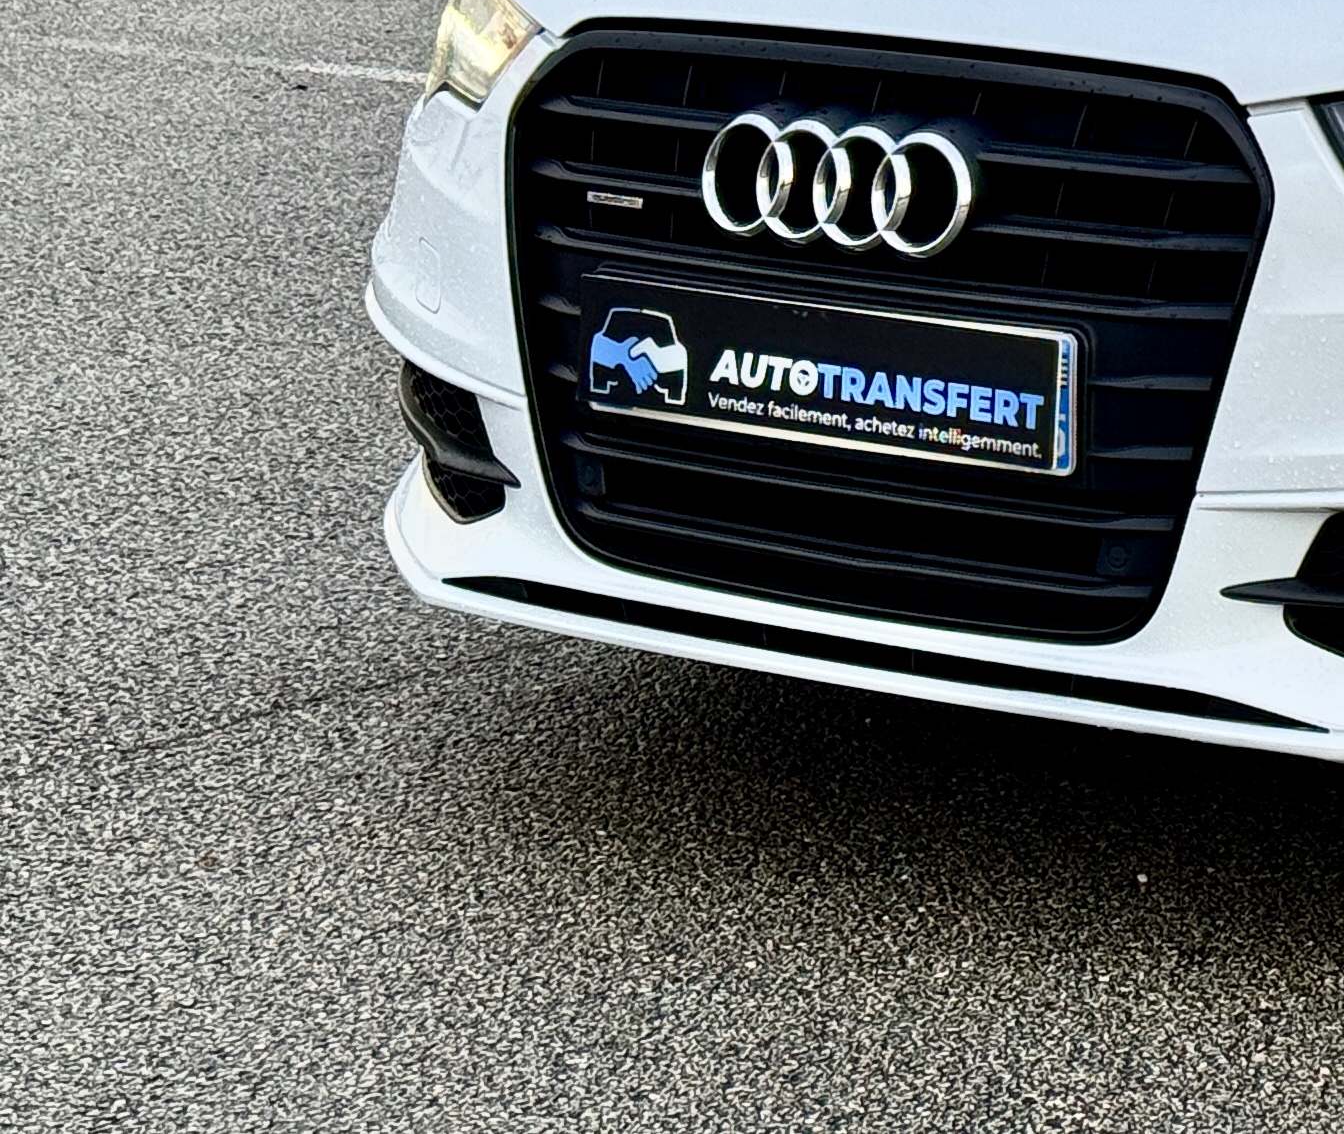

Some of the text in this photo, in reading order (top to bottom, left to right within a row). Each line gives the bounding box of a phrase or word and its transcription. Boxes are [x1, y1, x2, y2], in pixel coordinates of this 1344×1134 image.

[708, 392, 764, 416] Vendez
[767, 401, 852, 431] facilement,
[854, 416, 915, 439] achetez
[709, 349, 1044, 430] AUTOTRANSFERT
